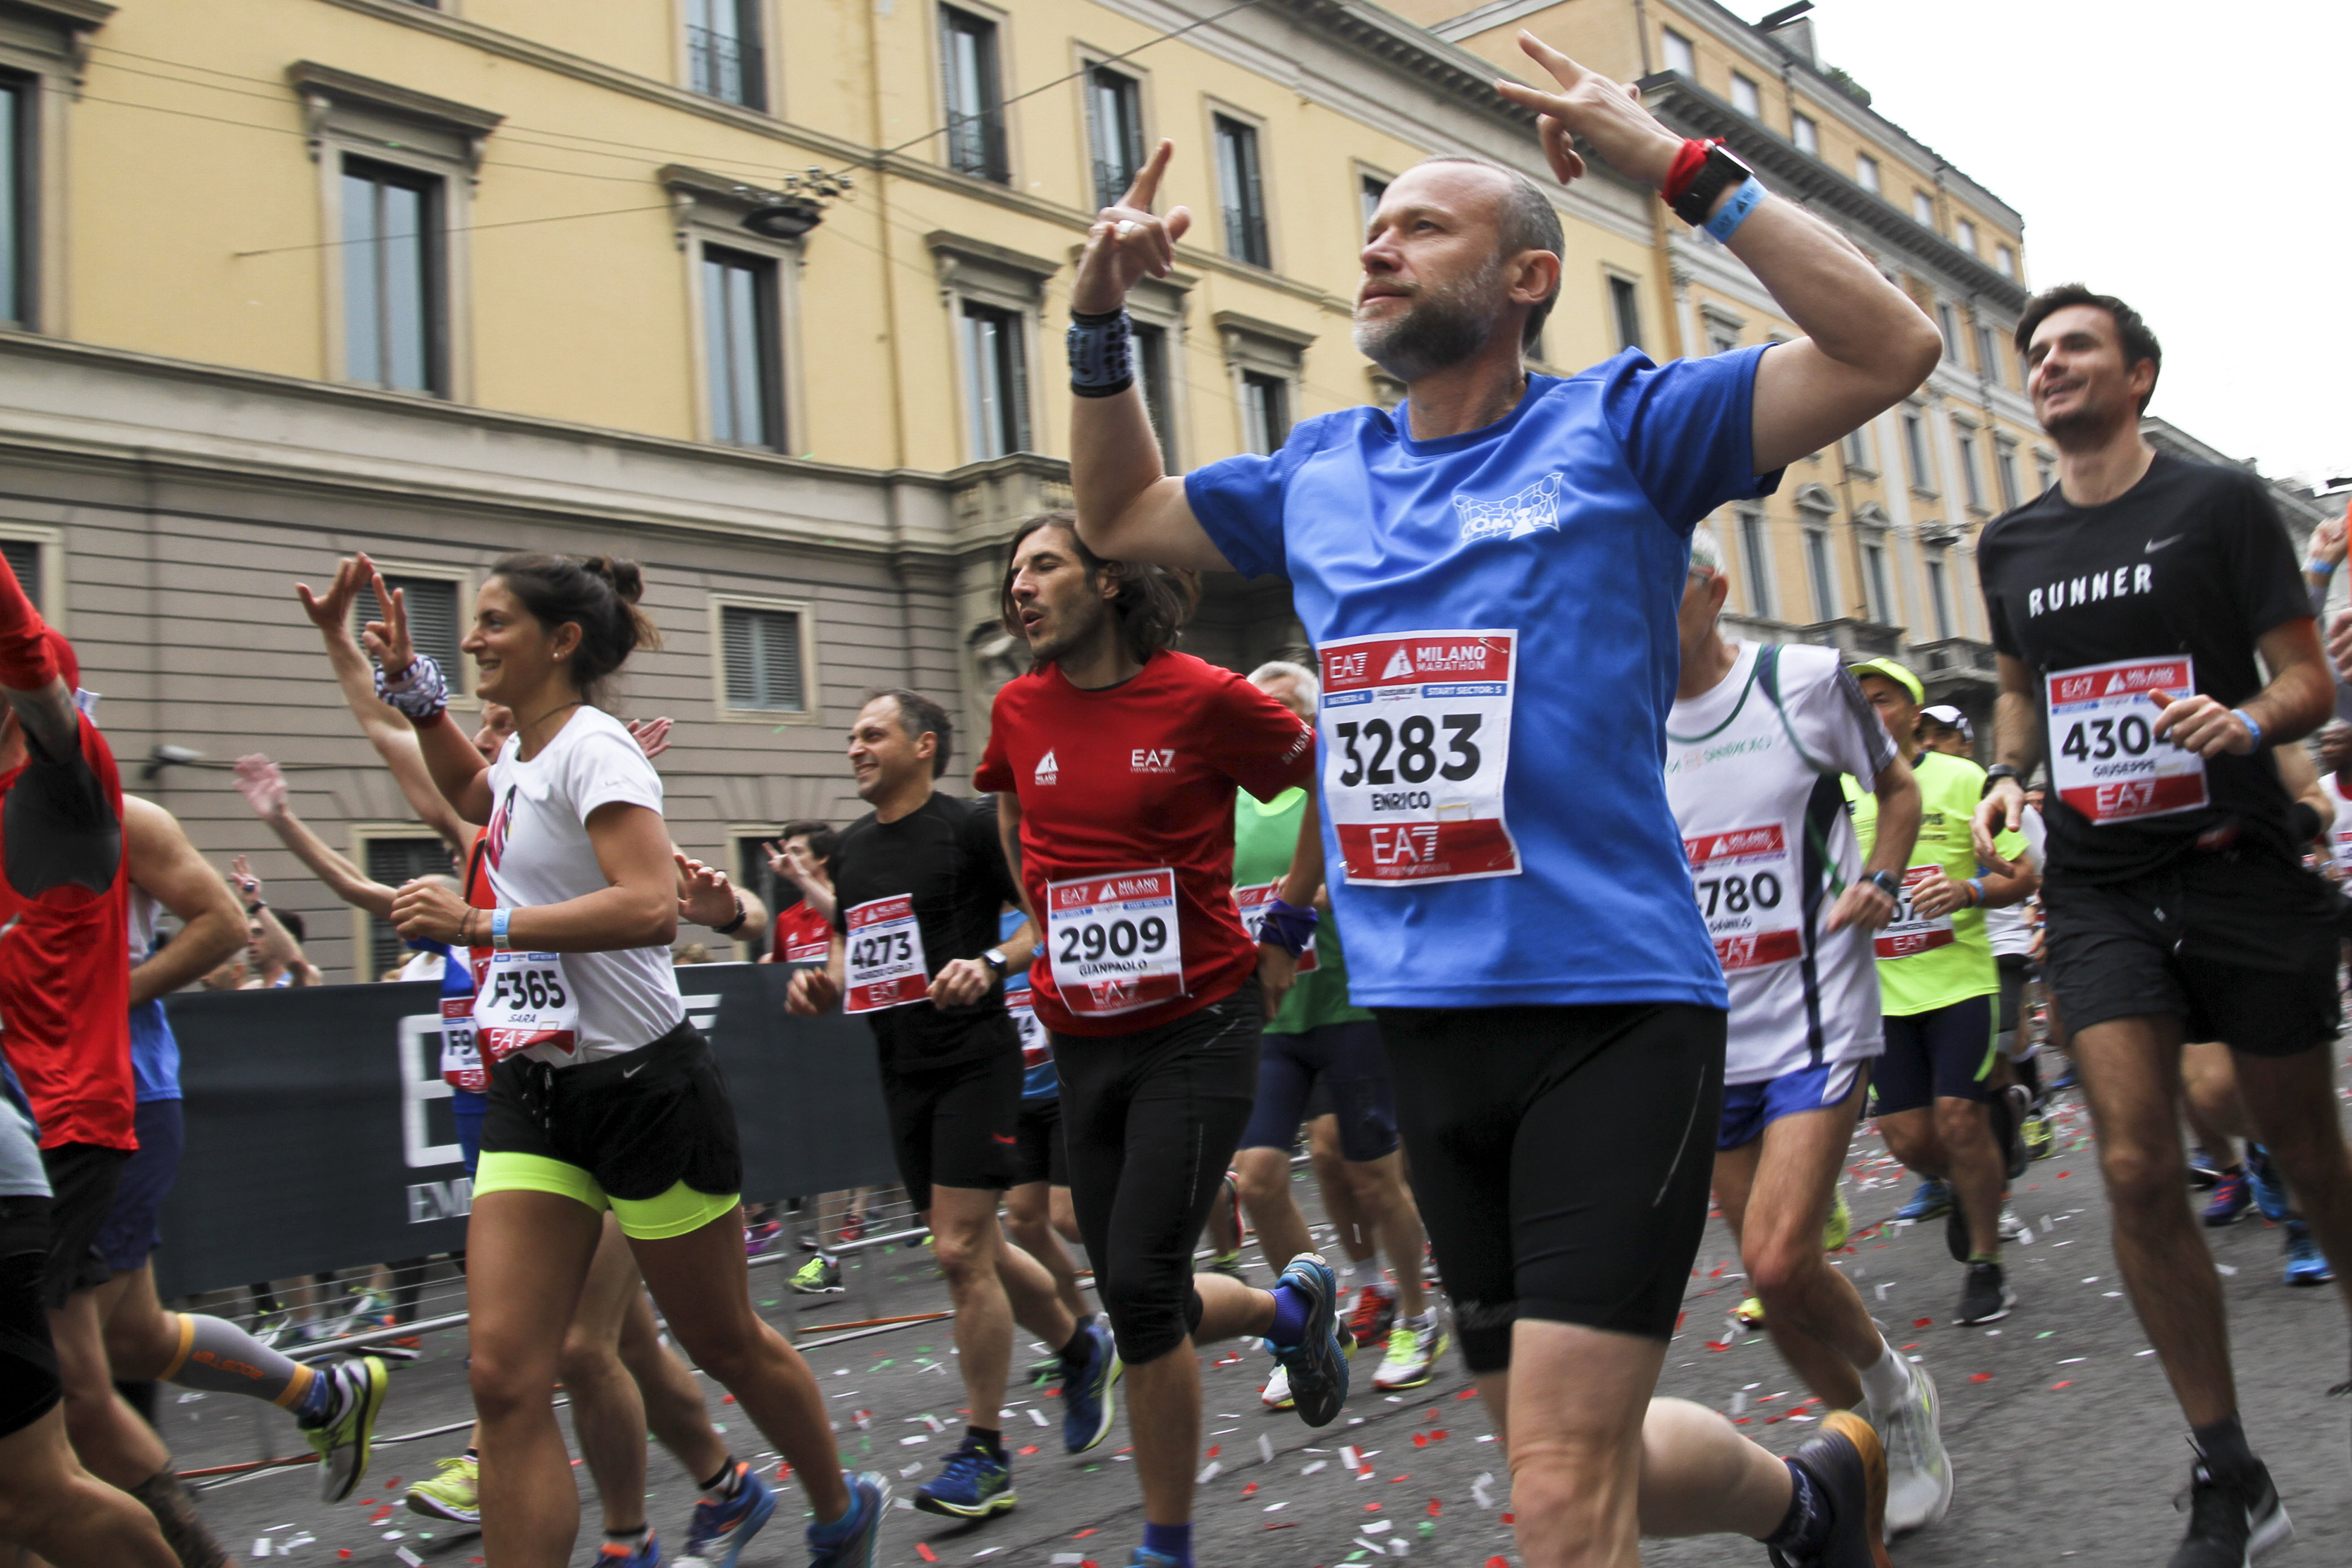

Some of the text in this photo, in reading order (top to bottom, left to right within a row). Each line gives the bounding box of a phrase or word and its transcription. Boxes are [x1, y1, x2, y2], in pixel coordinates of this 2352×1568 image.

[2028, 563, 2153, 619] RUNNER
[1330, 652, 1368, 679] EA7
[1416, 645, 1486, 662] MILANO
[1416, 660, 1486, 673] MARATHON
[1427, 687, 1454, 696] START
[1131, 748, 1176, 768] EA7
[1336, 713, 1483, 786] 3283
[1371, 790, 1431, 812] ENRICO
[2096, 779, 2157, 811] EA7
[1369, 825, 1440, 864] EA7
[1118, 877, 1159, 890] MILANO
[1696, 872, 1782, 919] 780
[851, 931, 912, 969] 4273
[1059, 916, 1167, 964] 2909
[1893, 933, 1928, 952] EA7
[1079, 958, 1148, 976] GIANPAOLO
[486, 970, 566, 1010] F365
[508, 1013, 537, 1024] SARA
[447, 1029, 479, 1056] F9
[490, 1028, 538, 1051] EA7
